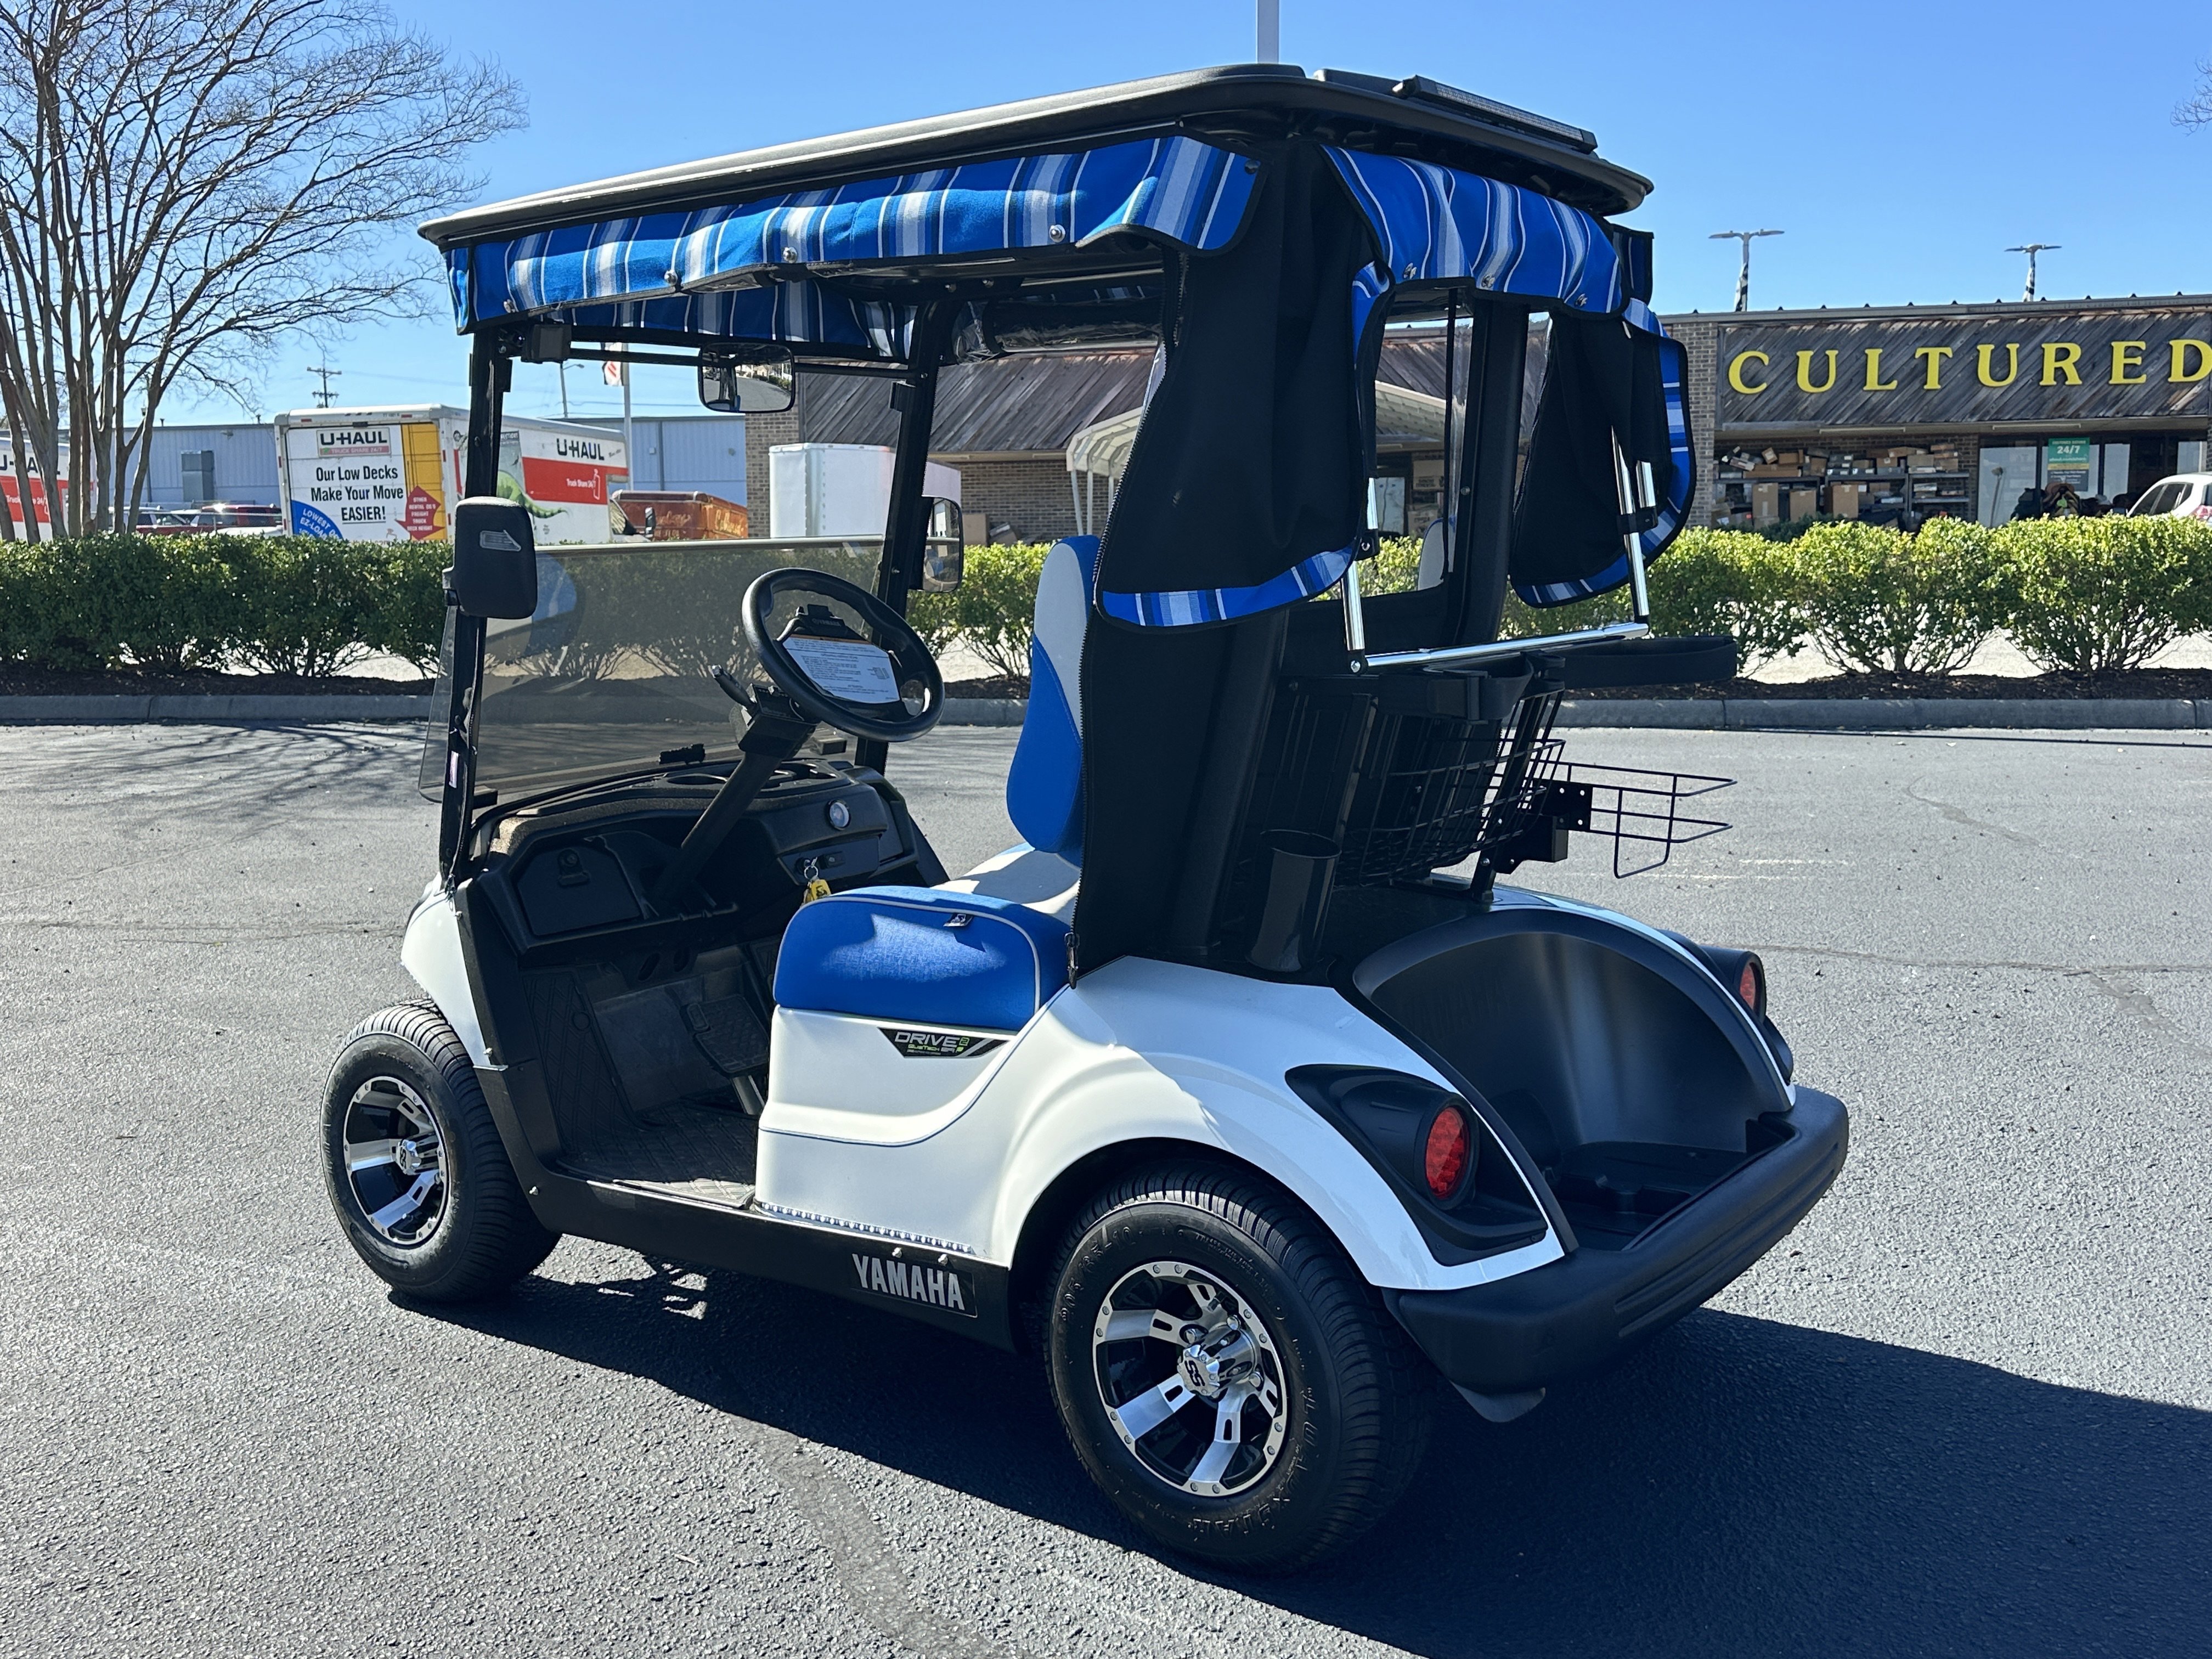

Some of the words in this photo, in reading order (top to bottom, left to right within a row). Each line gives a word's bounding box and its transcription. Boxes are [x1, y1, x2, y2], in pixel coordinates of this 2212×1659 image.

[1728, 339, 2212, 394] CULTURED
[320, 431, 387, 445] U-HAUL
[556, 438, 605, 460] U-HAUL
[2057, 445, 2080, 454] 24/7
[316, 467, 335, 481] Our
[338, 466, 360, 480] Low
[363, 465, 398, 479] Decks
[311, 487, 342, 501] Make
[345, 486, 370, 500] Your
[373, 485, 403, 500] Move
[303, 508, 331, 530] LOWEST
[341, 506, 386, 521] EASIER!
[852, 1254, 966, 1311] YAMAHA
